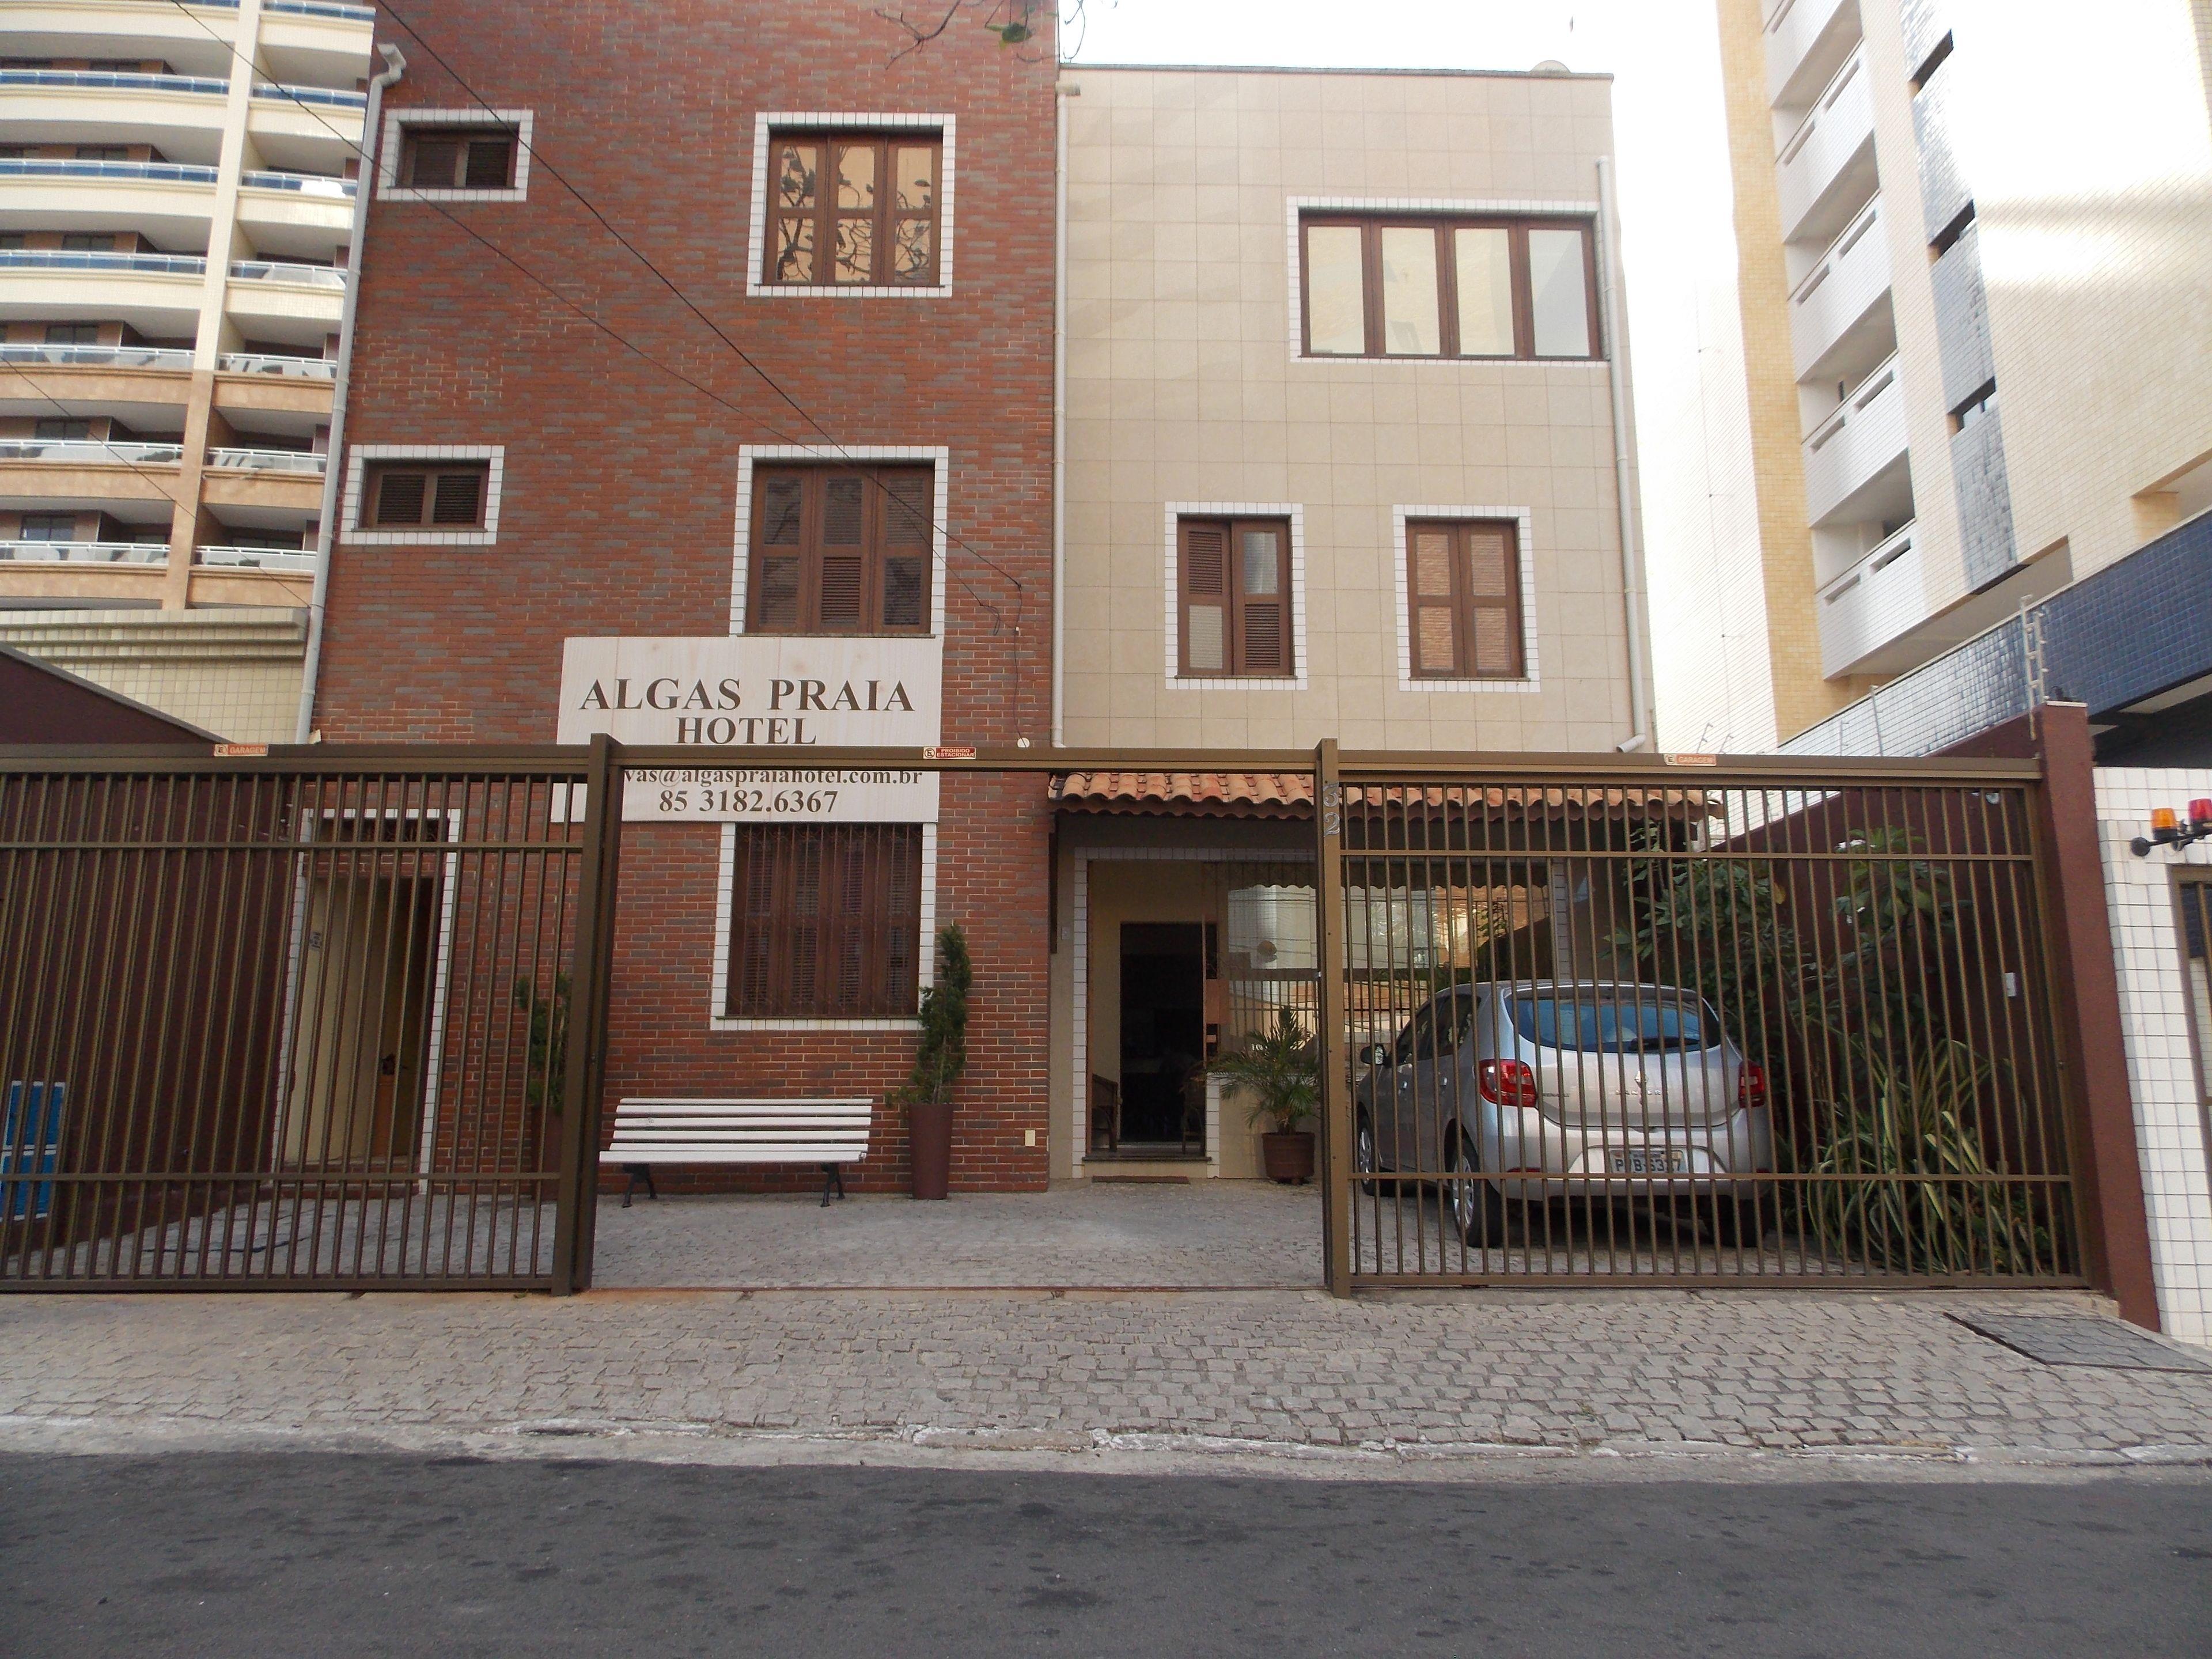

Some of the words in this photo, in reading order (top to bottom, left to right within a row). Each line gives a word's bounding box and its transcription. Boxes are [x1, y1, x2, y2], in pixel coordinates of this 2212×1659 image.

[579, 678, 741, 711] ALGAS
[768, 679, 915, 712] PRAIA
[675, 717, 817, 745] HOTEL
[659, 790, 688, 812] 85
[699, 789, 838, 813] 3182.6367
